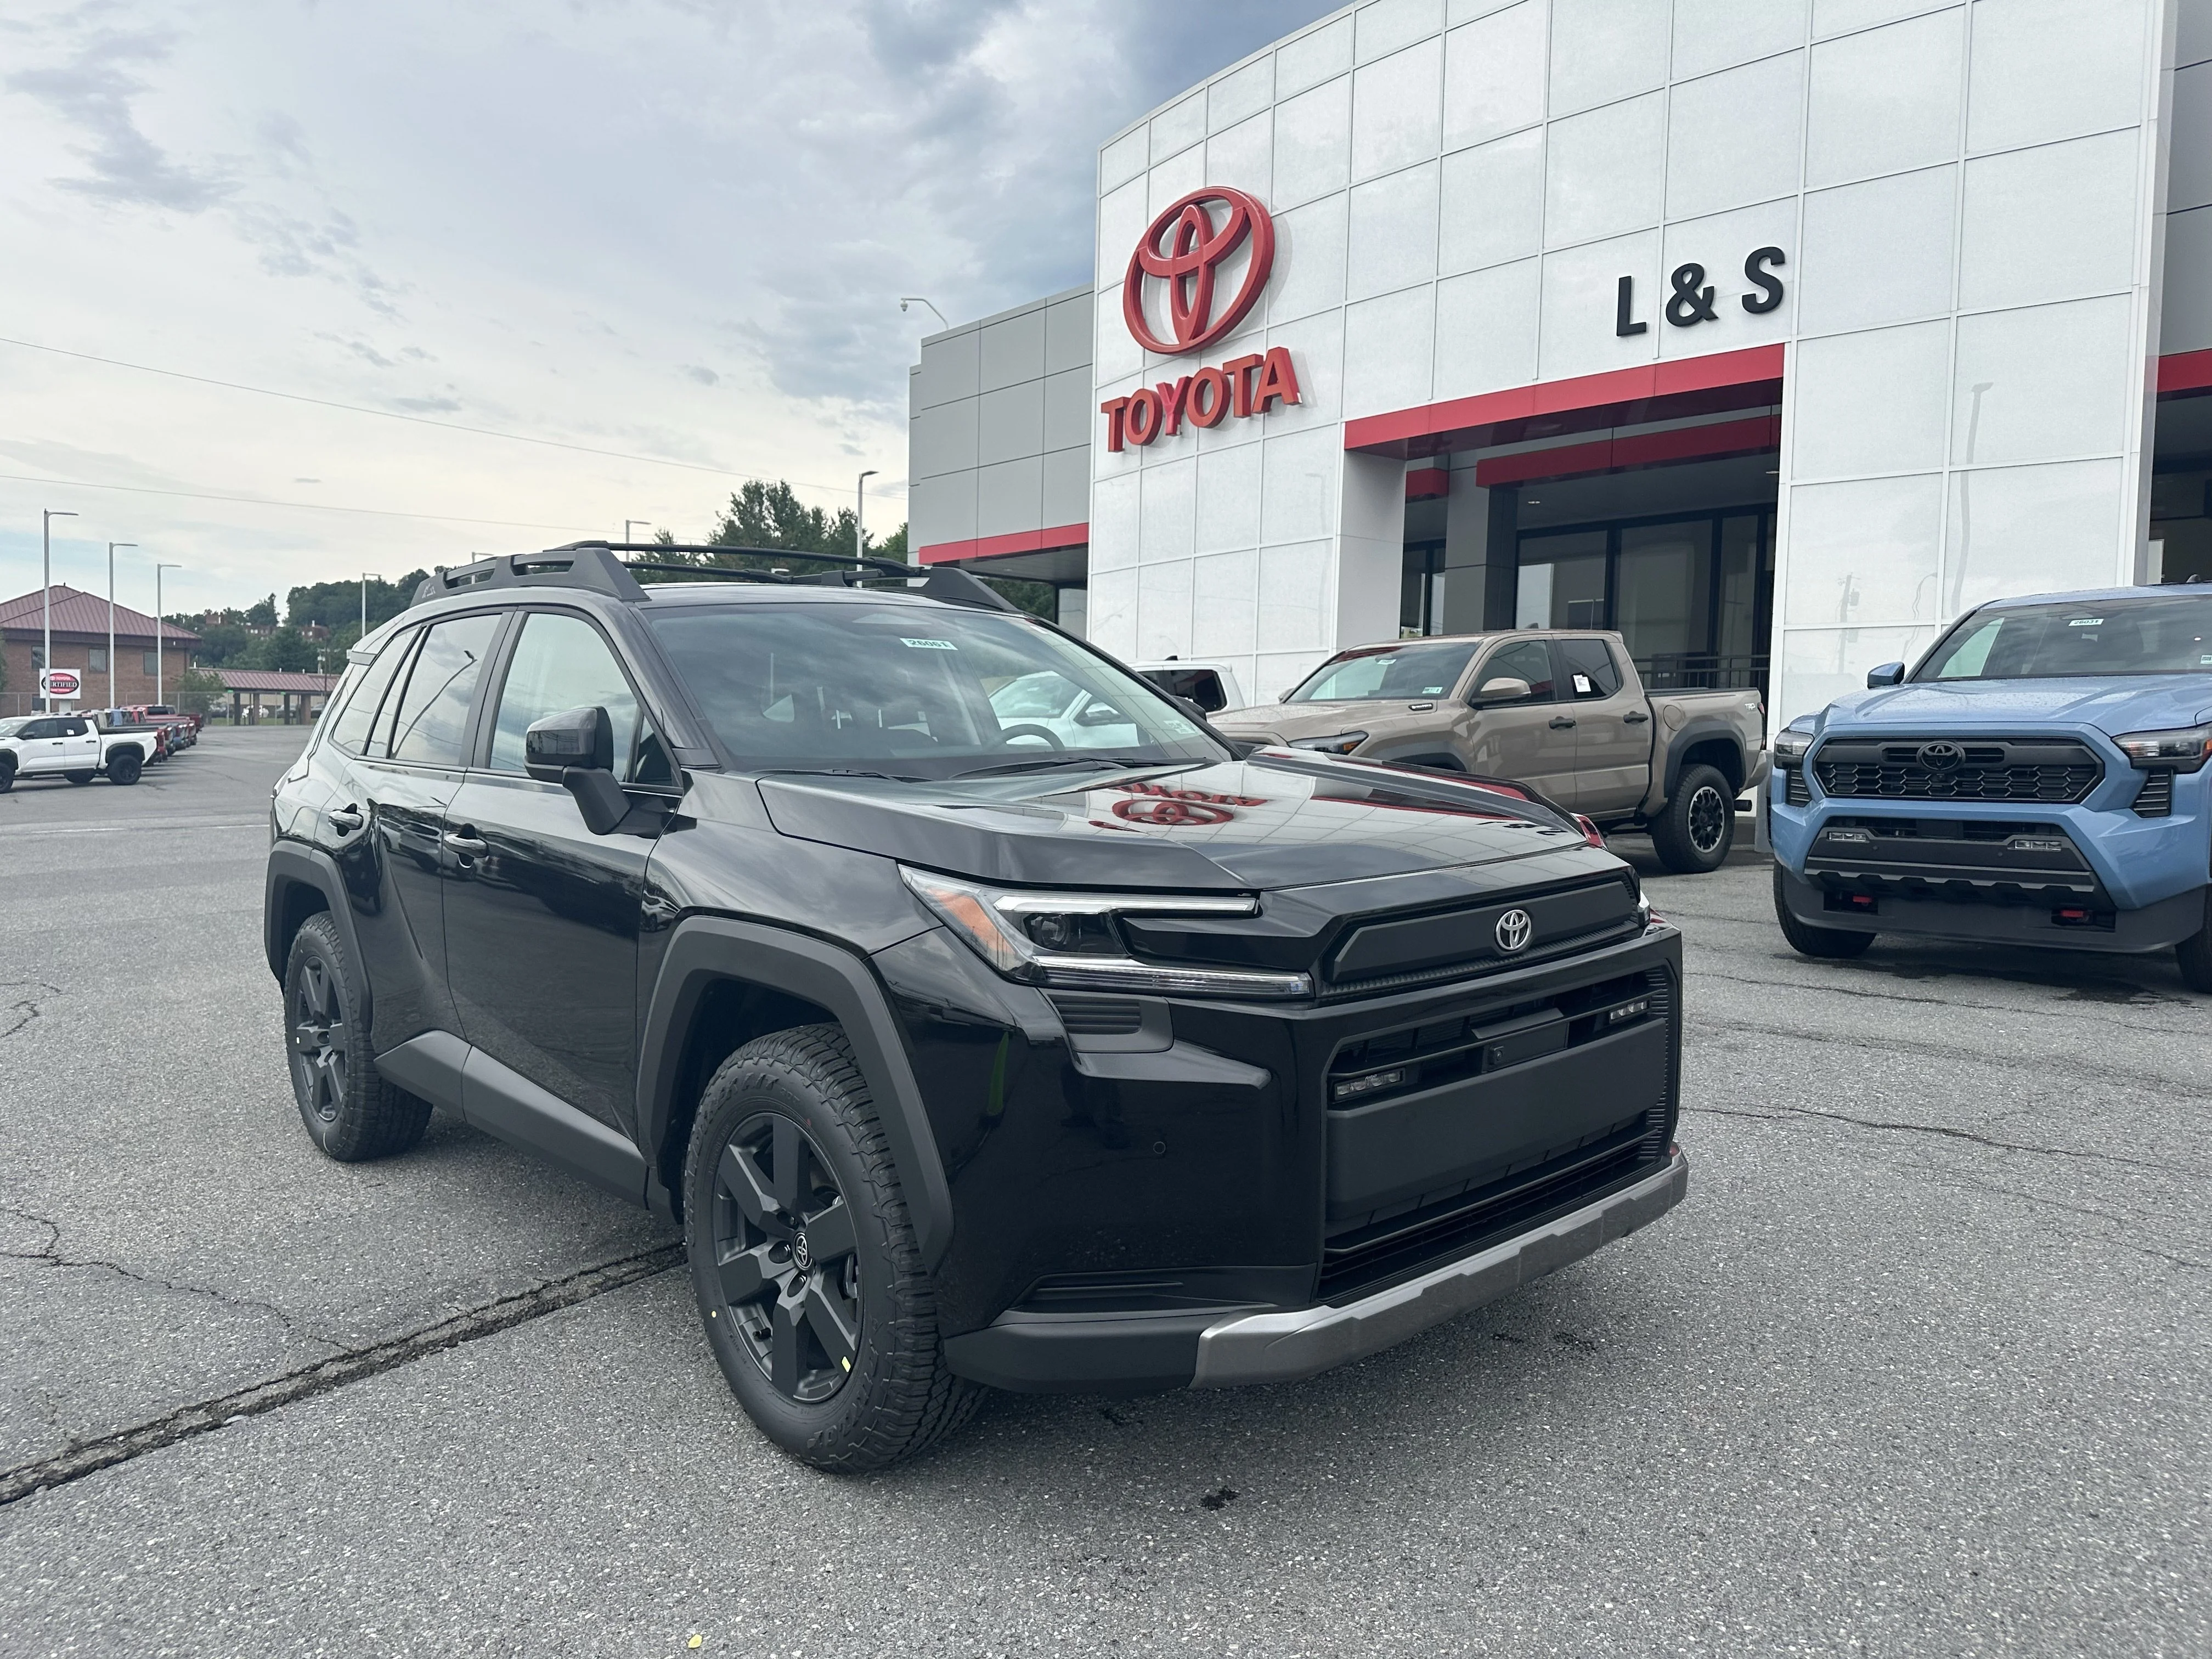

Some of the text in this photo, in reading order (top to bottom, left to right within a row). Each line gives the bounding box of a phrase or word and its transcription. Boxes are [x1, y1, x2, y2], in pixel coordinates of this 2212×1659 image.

[1617, 246, 1785, 336] L & S
[1101, 347, 1302, 452] TOYOTA
[1745, 702, 1756, 710] TRD
